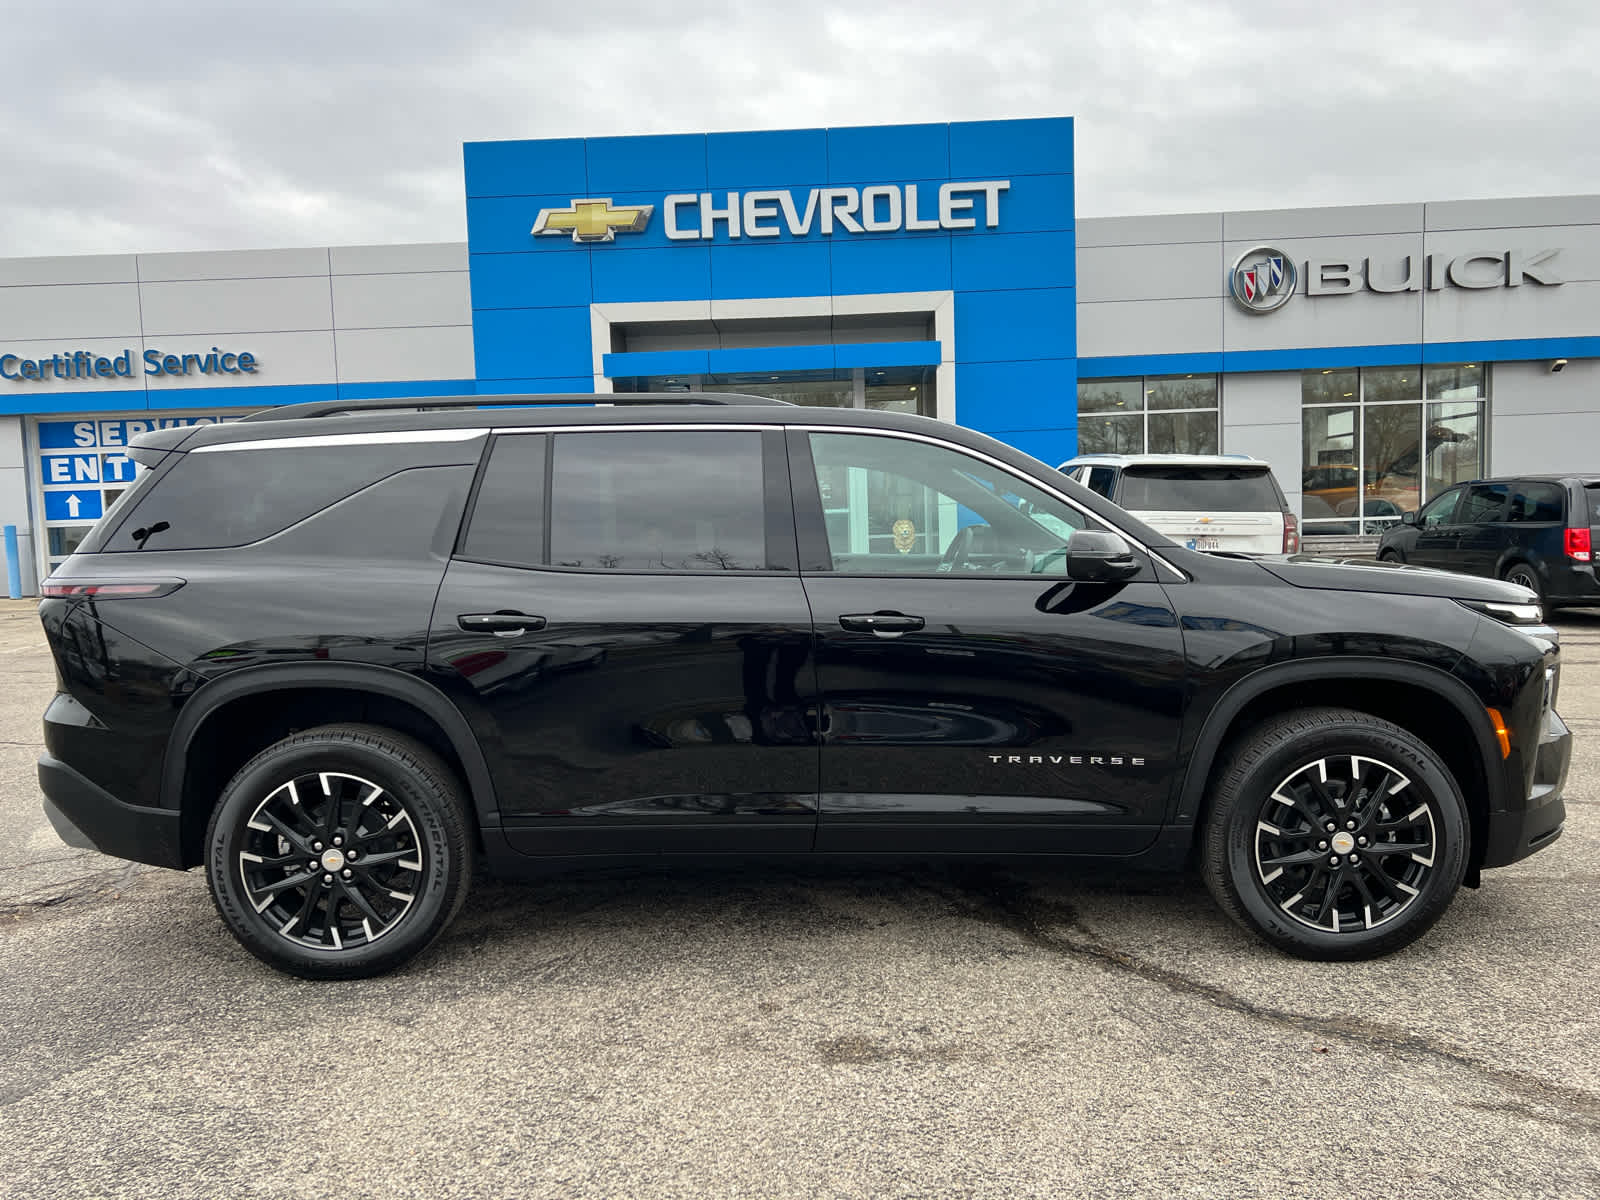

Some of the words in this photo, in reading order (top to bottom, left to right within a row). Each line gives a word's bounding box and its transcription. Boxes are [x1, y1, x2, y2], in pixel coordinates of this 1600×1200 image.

[663, 180, 1010, 240] CHEVROLET
[1305, 248, 1566, 297] BUICK
[0, 350, 131, 379] Certified
[143, 347, 256, 376] Service
[988, 755, 1145, 766] TRAVERSE
